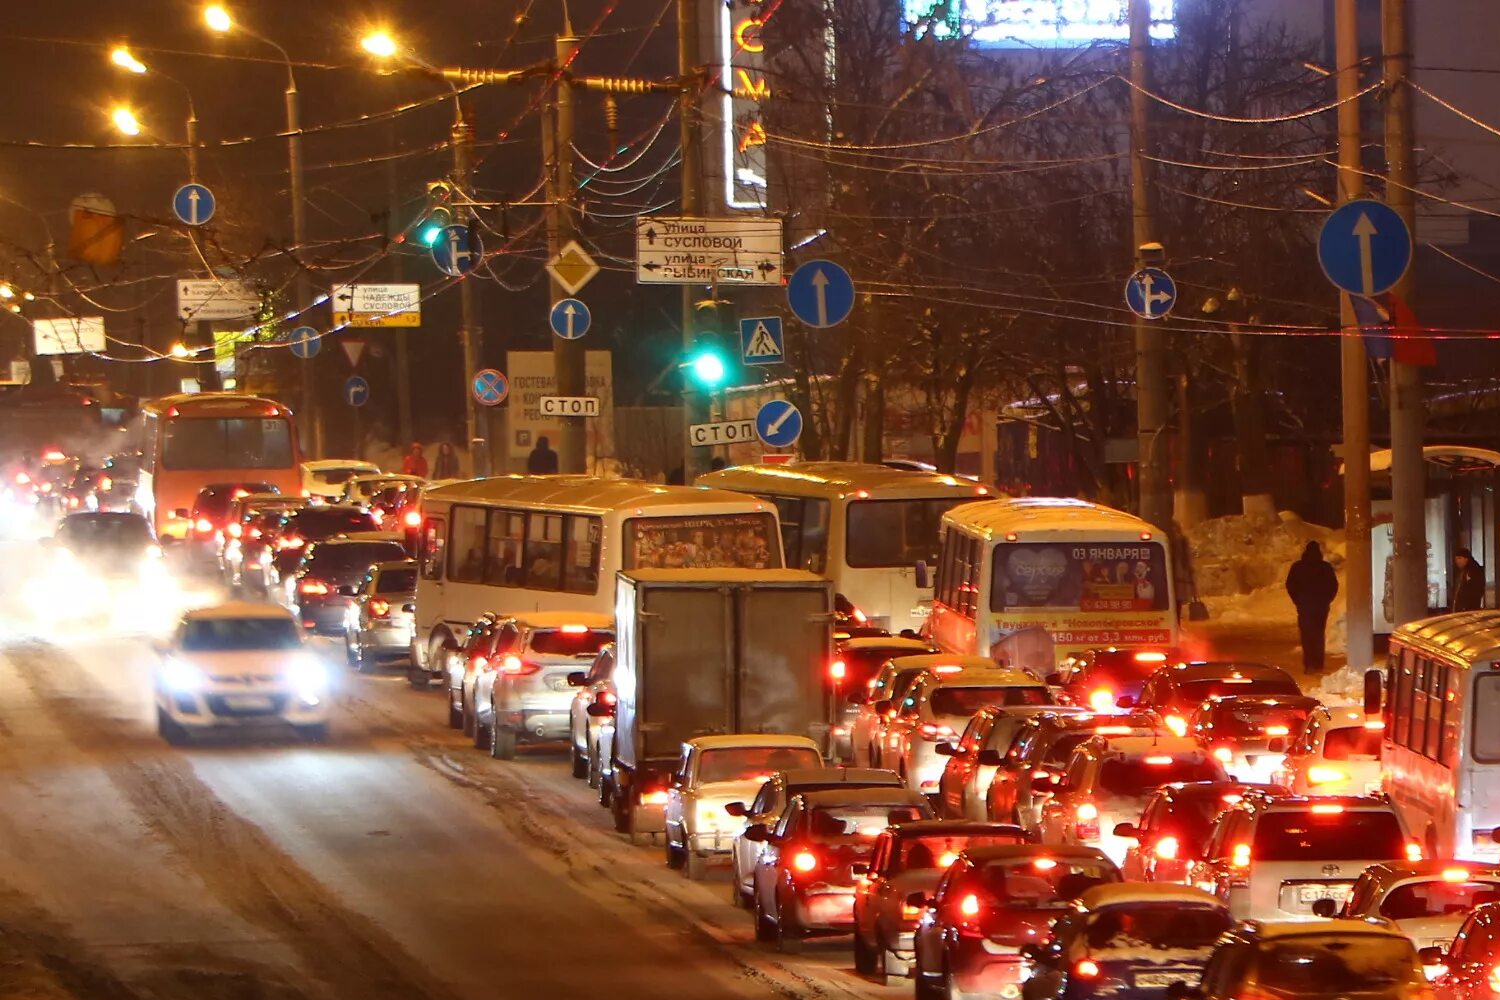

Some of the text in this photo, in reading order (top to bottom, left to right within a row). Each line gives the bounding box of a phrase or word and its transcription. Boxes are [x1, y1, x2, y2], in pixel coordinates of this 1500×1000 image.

[664, 223, 706, 234] улица
[664, 235, 742, 249] СУСЛОВОЙ
[664, 254, 706, 265] улица
[363, 293, 410, 301] НАДЕЖДЫ
[544, 399, 595, 413] СТОП
[695, 423, 752, 442] СТОП
[1072, 548, 1086, 560] 03
[1089, 547, 1140, 560] ЯНВАРЯ
[1102, 631, 1120, 644] 3,3
